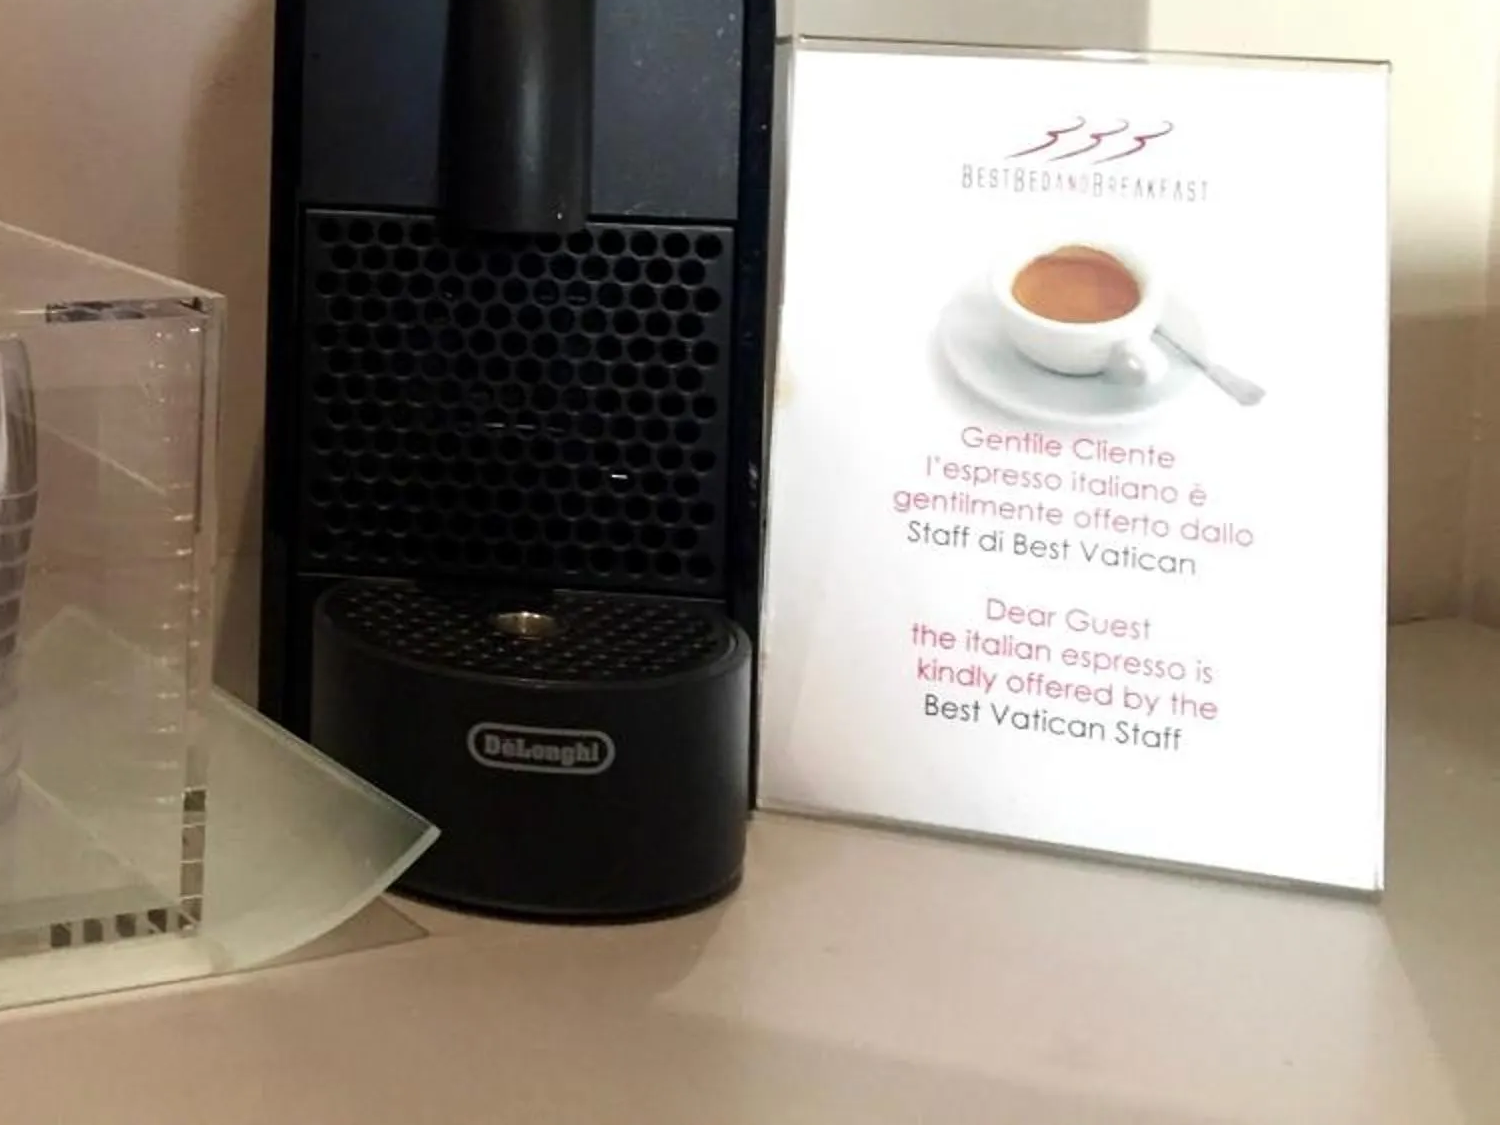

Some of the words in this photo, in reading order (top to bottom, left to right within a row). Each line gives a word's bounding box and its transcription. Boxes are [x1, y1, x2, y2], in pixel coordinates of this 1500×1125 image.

[961, 426, 1063, 457] Gentile
[1072, 437, 1176, 469] Cliente
[926, 455, 1062, 491] l'espresso
[1071, 471, 1178, 504] italiano
[1188, 482, 1208, 507] è
[893, 489, 1064, 525] gentilmente
[1073, 508, 1170, 537] offerto
[1180, 518, 1254, 547] dallo
[907, 520, 970, 548] Staff
[979, 530, 1004, 553] di
[1012, 533, 1070, 561] Best
[1080, 541, 1197, 575] Vatican
[986, 598, 1056, 628] Dear
[1065, 608, 1152, 640] Guest
[911, 623, 956, 650] the
[965, 629, 1051, 662] italian
[1061, 647, 1187, 681] espresso
[1195, 661, 1213, 684] is
[916, 658, 997, 693] kindly
[1006, 673, 1113, 706] offered
[1123, 686, 1160, 719] by
[1171, 693, 1219, 721] the
[924, 694, 980, 722] Best
[990, 703, 1105, 741] Vatican
[1114, 720, 1183, 751] Staff
